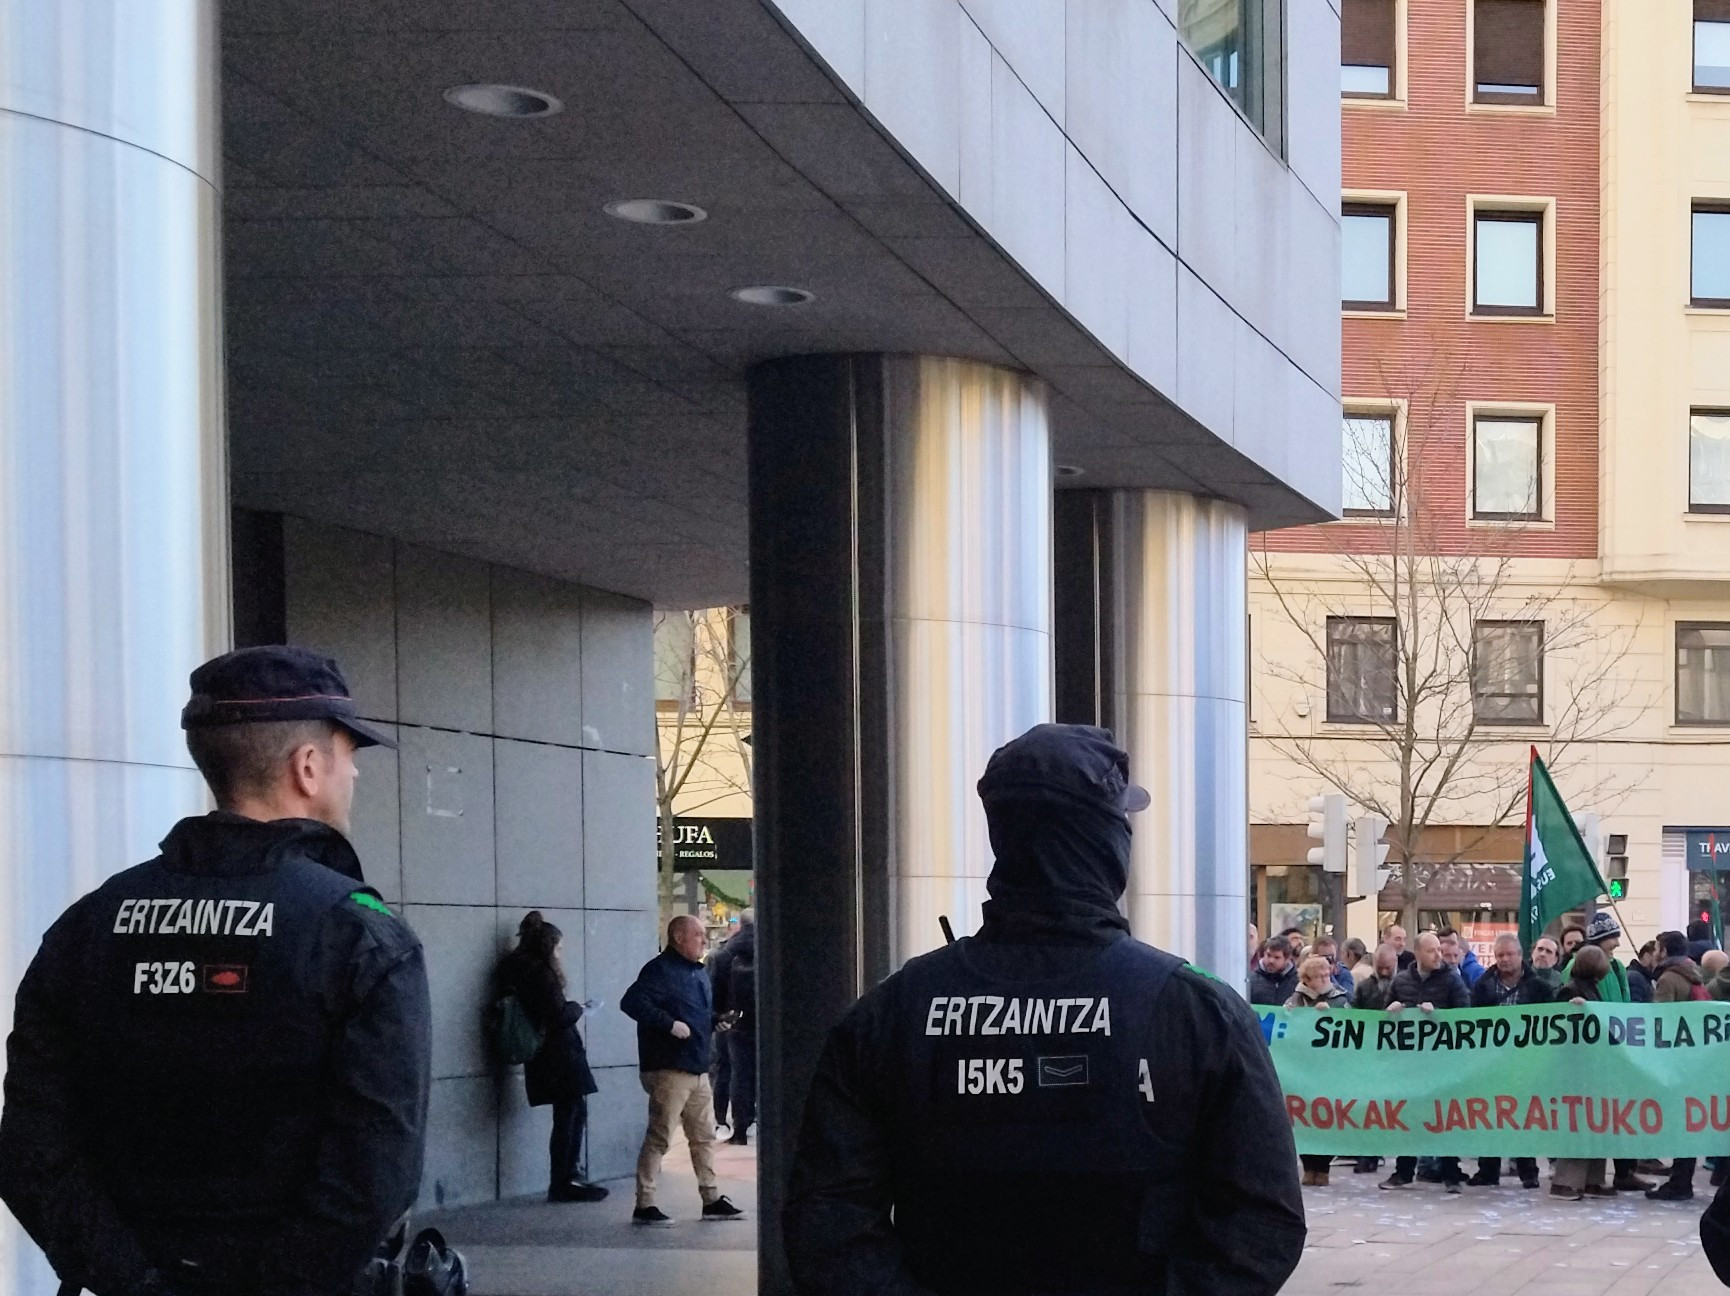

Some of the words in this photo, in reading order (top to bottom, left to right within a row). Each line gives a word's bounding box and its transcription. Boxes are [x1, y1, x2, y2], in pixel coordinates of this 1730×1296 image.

[657, 825, 714, 844] UFA
[680, 850, 714, 858] REGALOS
[112, 898, 275, 937] ERTZAINTZA
[133, 961, 196, 994] F3Z6
[925, 996, 1111, 1036] ERTZAINTZA
[1376, 1019, 1511, 1051] REPARTO
[1514, 1013, 1600, 1047] JUSTO
[1609, 1016, 1646, 1047] DE
[1654, 1015, 1695, 1048] LA
